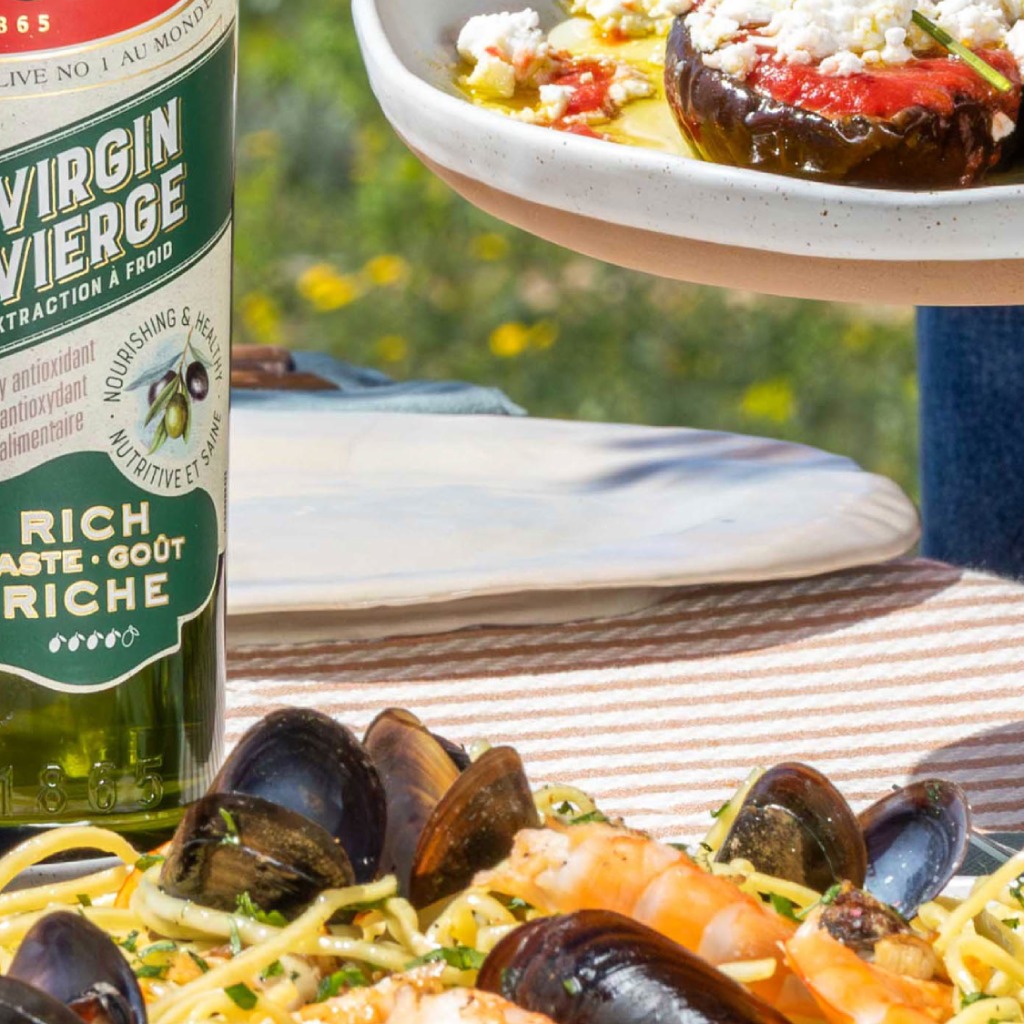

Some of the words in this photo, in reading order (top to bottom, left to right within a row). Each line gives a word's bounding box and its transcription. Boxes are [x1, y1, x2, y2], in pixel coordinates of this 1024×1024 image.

[57, 61, 89, 81] NO
[121, 43, 149, 66] AU
[108, 264, 120, 289] À
[126, 241, 174, 281] FROID
[11, 339, 96, 387] antioxidant
[104, 308, 176, 403] NOURISHING
[181, 306, 190, 326] &
[195, 311, 223, 380] HEALTHY
[0, 375, 89, 430] antioxydant
[0, 411, 84, 462] alimentaire
[109, 428, 181, 489] NUTRITIVE
[186, 459, 200, 485] ET
[201, 411, 222, 466] SAINE
[20, 500, 151, 545] RICH
[108, 533, 186, 569] GOÛT
[3, 572, 169, 620] RICHE
